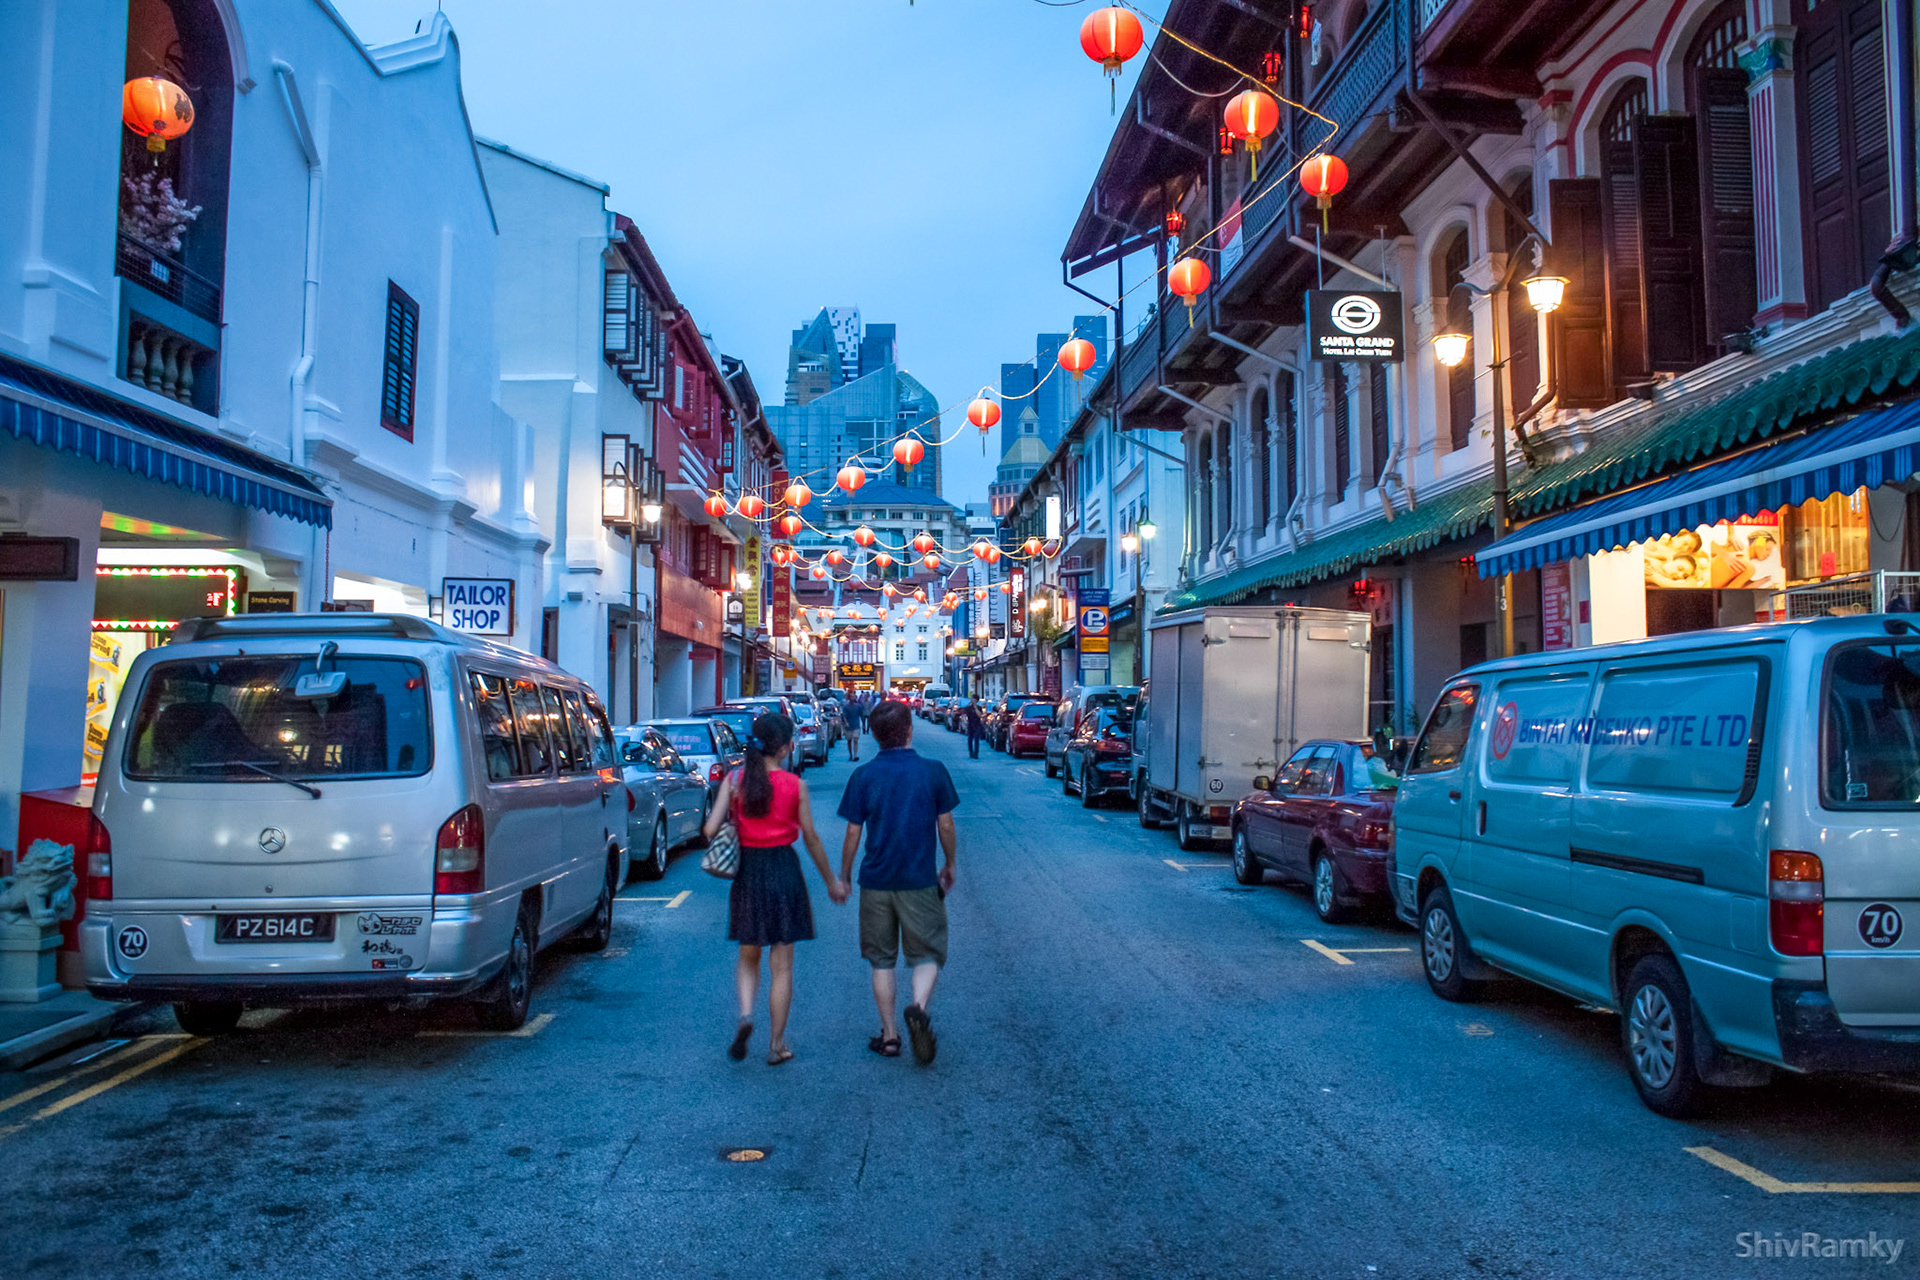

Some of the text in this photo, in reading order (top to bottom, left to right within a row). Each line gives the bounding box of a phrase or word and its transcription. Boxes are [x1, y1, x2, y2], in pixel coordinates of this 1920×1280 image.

[1320, 336, 1395, 348] SANTA GRAND
[447, 585, 506, 606] TAILOR
[452, 609, 500, 630] SHOP
[1655, 716, 1697, 745] PTE
[1700, 715, 1747, 746] LTD
[1211, 781, 1222, 789] 60
[237, 918, 314, 937] PZ614C
[1864, 911, 1899, 935] 70
[122, 931, 144, 947] 70
